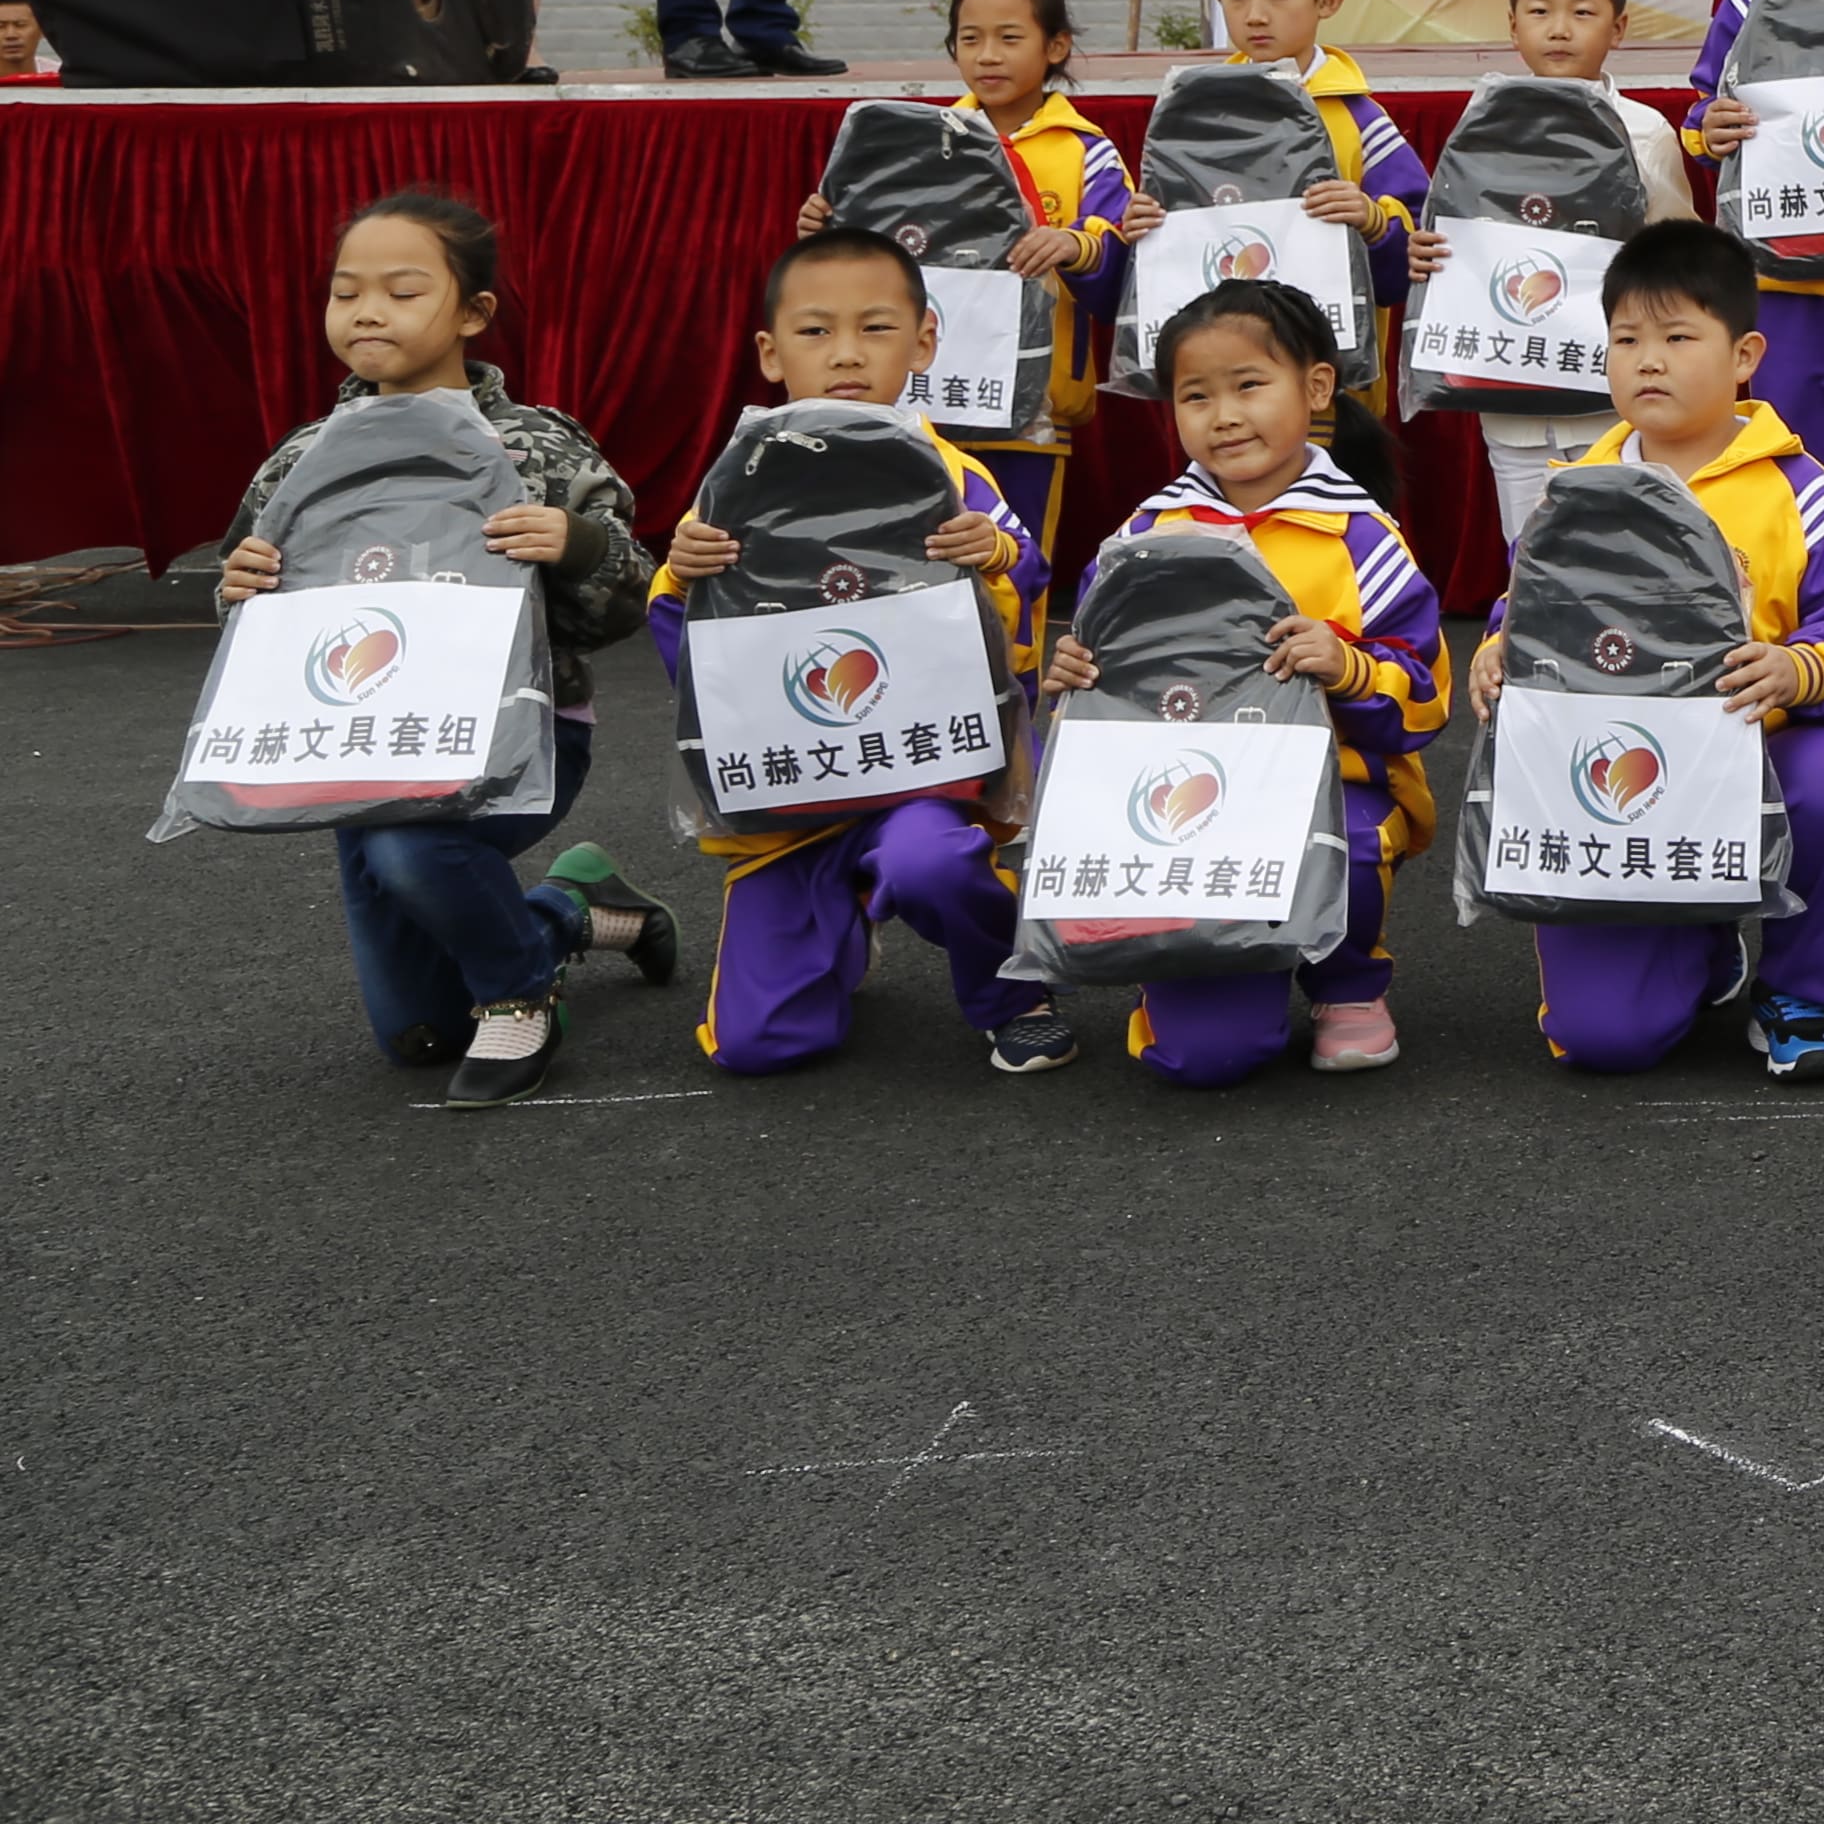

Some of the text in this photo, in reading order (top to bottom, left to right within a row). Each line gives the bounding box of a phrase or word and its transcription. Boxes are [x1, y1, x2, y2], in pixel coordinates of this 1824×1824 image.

[199, 712, 478, 765] 尚赫文具套组
[716, 712, 990, 793] 尚赫文具套组
[1033, 853, 1286, 899] 尚赫文具套组
[1496, 826, 1748, 882] 尚赫文具套组
